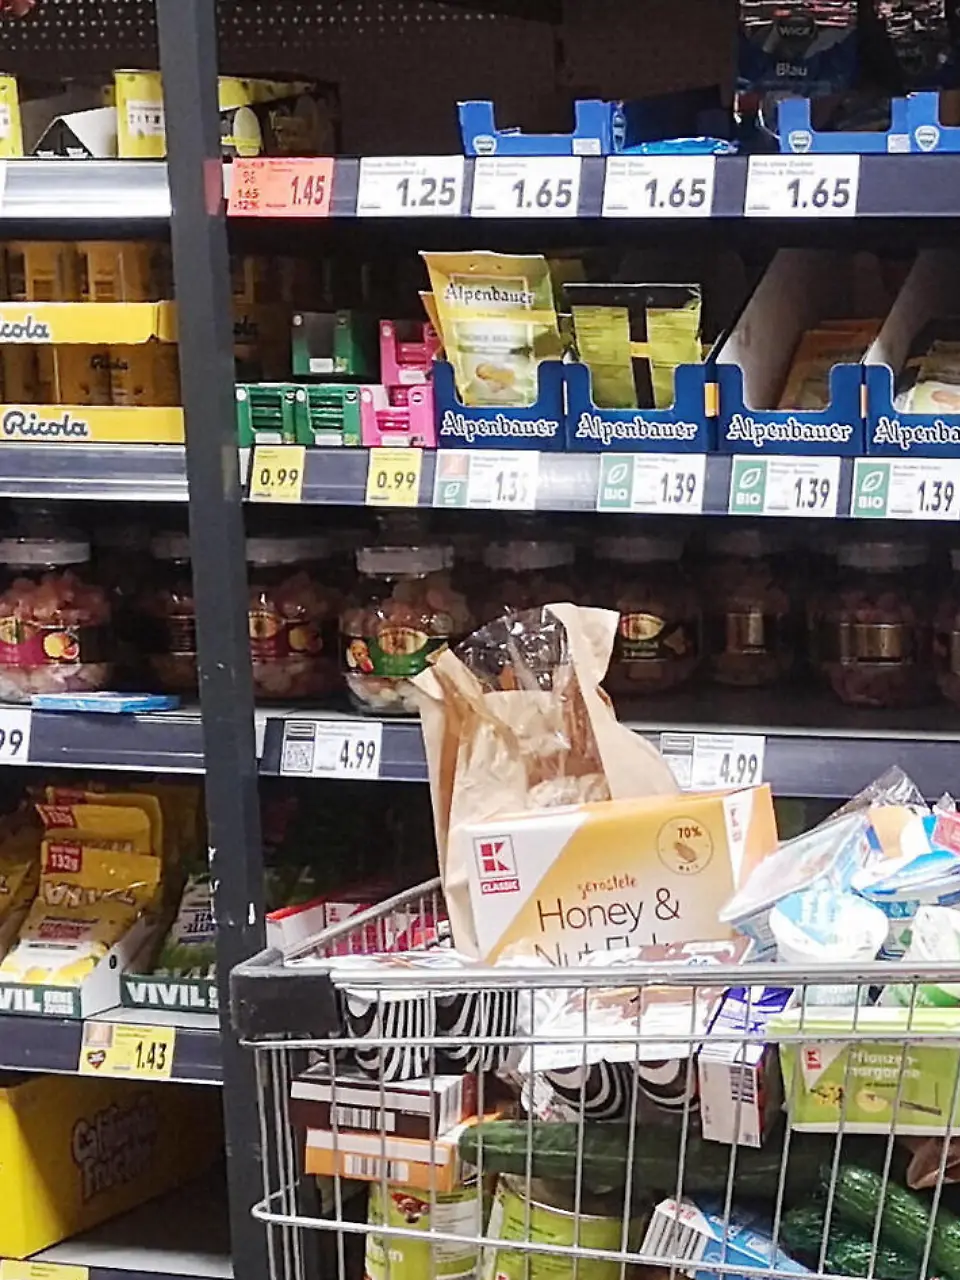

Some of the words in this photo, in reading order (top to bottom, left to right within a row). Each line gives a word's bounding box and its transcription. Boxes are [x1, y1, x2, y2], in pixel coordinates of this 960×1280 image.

[776, 62, 808, 77] Blau
[290, 175, 326, 206] 1.45
[396, 176, 457, 207] 1.25
[512, 178, 574, 209] 1.65
[644, 178, 708, 209] 1.65
[786, 177, 852, 209] 1.65
[444, 282, 536, 305] Alpenbauer
[2, 411, 89, 437] Ricola
[441, 411, 559, 442] Alpenbauer
[576, 412, 698, 443] Alpenbauer
[727, 414, 854, 447] Alpenbauer
[260, 468, 299, 488] 0.99
[377, 471, 416, 491] 0.99
[660, 471, 696, 504] 1.39
[794, 478, 831, 509] 1.39
[604, 489, 627, 501] BIO
[736, 495, 761, 506] BIO
[858, 496, 884, 509] BIO
[917, 481, 954, 513] 1.39
[339, 739, 376, 770] 4.99
[719, 752, 758, 784] 4.99
[677, 826, 704, 840] 70%
[536, 896, 645, 932] Honey
[654, 887, 682, 921] &
[126, 981, 205, 1008] VIVIL
[134, 1040, 168, 1070] 1.43
